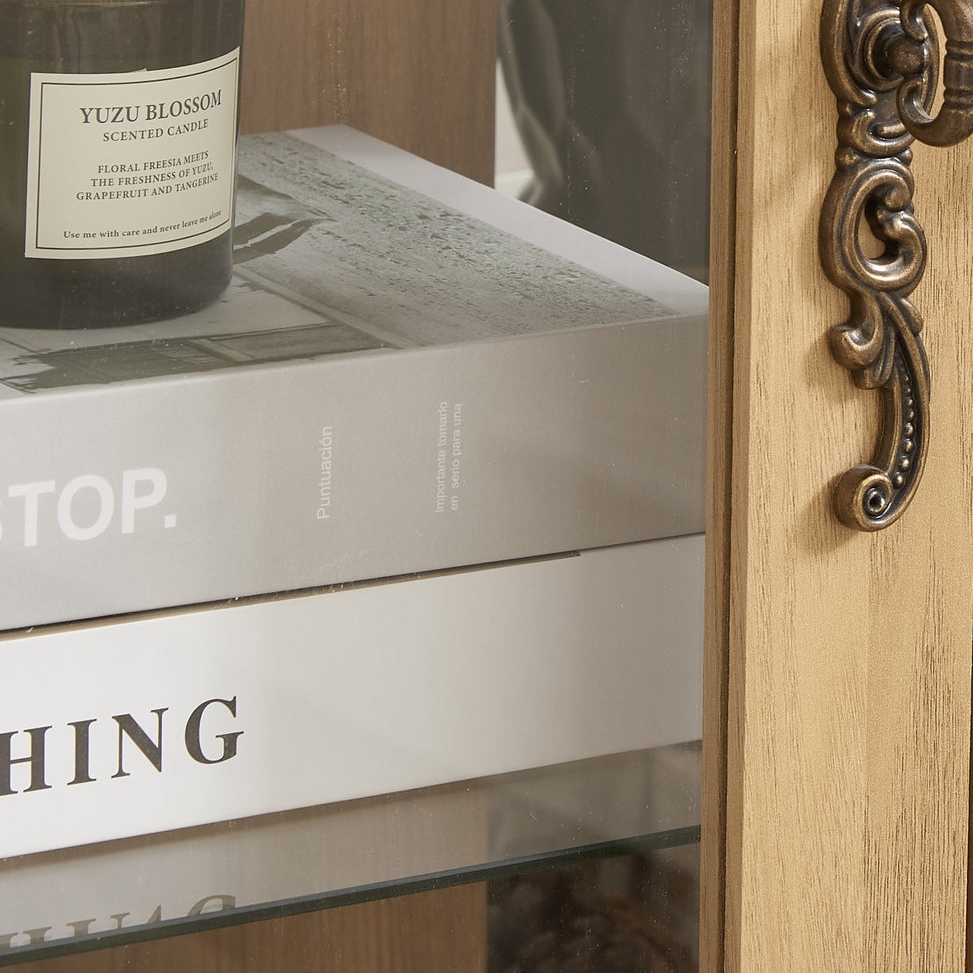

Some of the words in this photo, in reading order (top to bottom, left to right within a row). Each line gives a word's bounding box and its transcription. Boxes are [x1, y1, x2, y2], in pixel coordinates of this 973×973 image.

[80, 106, 141, 124] YUZU
[145, 89, 222, 121] BLOSSOM
[103, 128, 164, 142] SCENTED
[167, 118, 209, 137] CANDLE
[98, 163, 141, 174] FLORAL
[143, 158, 182, 171] FREESIA
[183, 150, 209, 165] MEETS
[76, 188, 149, 201] GRAPEFRUIT
[151, 185, 173, 197] AND
[175, 172, 219, 193] TANGERINE
[91, 178, 114, 187] THE
[118, 171, 176, 186] FRESHNESS
[178, 168, 190, 178] OF
[63, 230, 80, 239] Use
[99, 229, 120, 238] with
[122, 229, 140, 237] care
[142, 226, 158, 235] and
[159, 223, 180, 233] never
[181, 218, 198, 229] leave
[199, 216, 208, 224] me
[208, 210, 222, 221] alone
[453, 403, 462, 426] una
[451, 429, 463, 455] para
[316, 425, 333, 520] Puntuación
[435, 450, 447, 513] Importante
[451, 458, 460, 489] serio
[0, 467, 177, 548] TOP.
[450, 494, 459, 511] en
